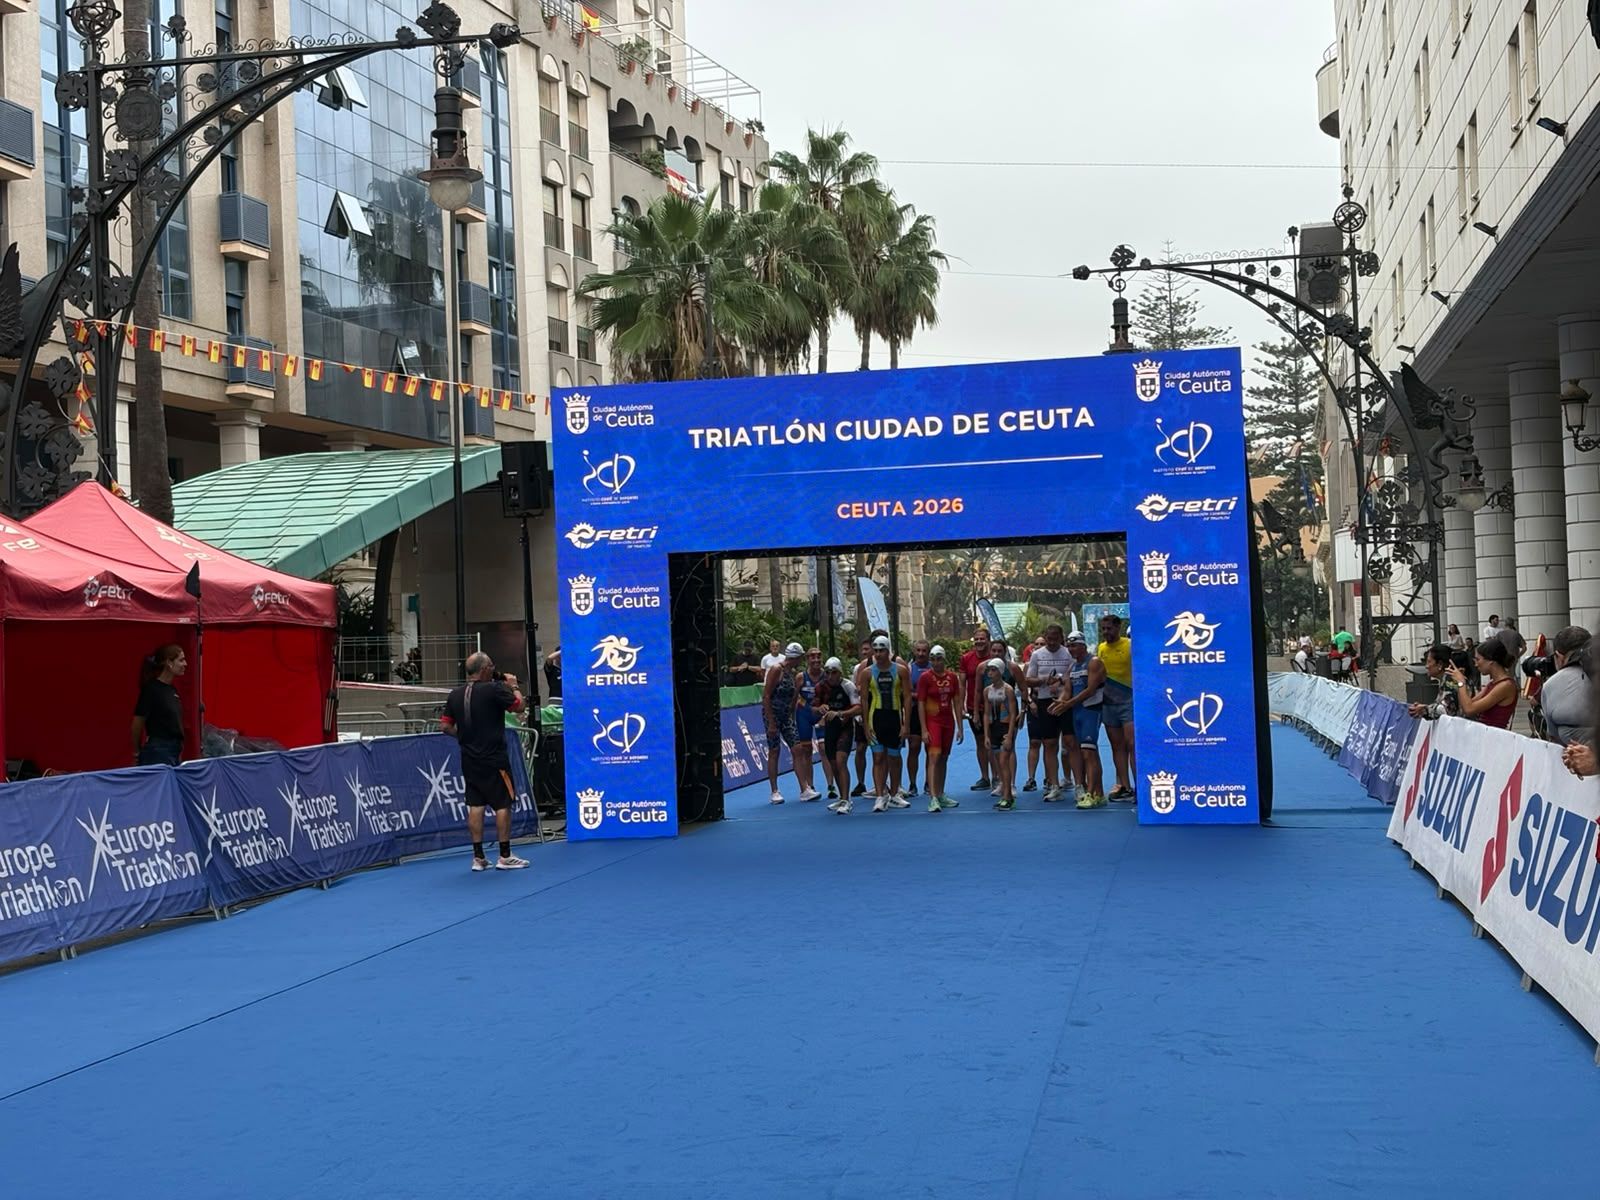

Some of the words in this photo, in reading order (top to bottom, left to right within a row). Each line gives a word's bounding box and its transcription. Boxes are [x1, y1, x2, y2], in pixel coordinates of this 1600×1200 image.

[1164, 371, 1190, 380] Ciudad
[1192, 369, 1231, 378] Autónoma
[1165, 380, 1175, 388] de
[1179, 378, 1232, 394] Ceuta
[592, 405, 617, 413] Ciudad
[618, 404, 654, 412] Autónoma
[592, 414, 603, 422] de
[606, 412, 654, 427] Ceuta
[688, 418, 827, 450] TRIATLÓN
[835, 416, 944, 442] CIUDAD
[952, 412, 990, 435] DE
[998, 406, 1095, 432] CEUTA
[837, 501, 907, 520] CEUTA
[912, 498, 965, 516] 2026
[1171, 563, 1198, 572] Ciudad
[1199, 561, 1238, 570] Autónoma
[1172, 572, 1183, 580] de
[1186, 571, 1239, 586] Ceuta
[597, 587, 622, 595] Ciudad
[624, 585, 660, 593] Autónoma
[598, 595, 609, 603] de
[611, 594, 660, 609] Ceuta
[1159, 650, 1226, 665] FETRICE
[586, 672, 648, 687] FETRICE
[1179, 784, 1206, 793] Ciudad
[1207, 783, 1246, 792] Autónoma
[605, 801, 630, 809] Ciudad
[631, 800, 667, 808] Autónoma
[1180, 793, 1191, 801] de
[1194, 792, 1247, 807] Ceuta
[1417, 749, 1486, 854] SUZUKI
[296, 794, 339, 821] Europe
[213, 807, 269, 836] Europe
[606, 809, 617, 817] de
[619, 808, 668, 823] Ceuta
[104, 820, 176, 855] Europe
[1509, 793, 1600, 955] SUZU
[0, 875, 86, 921] riathlon
